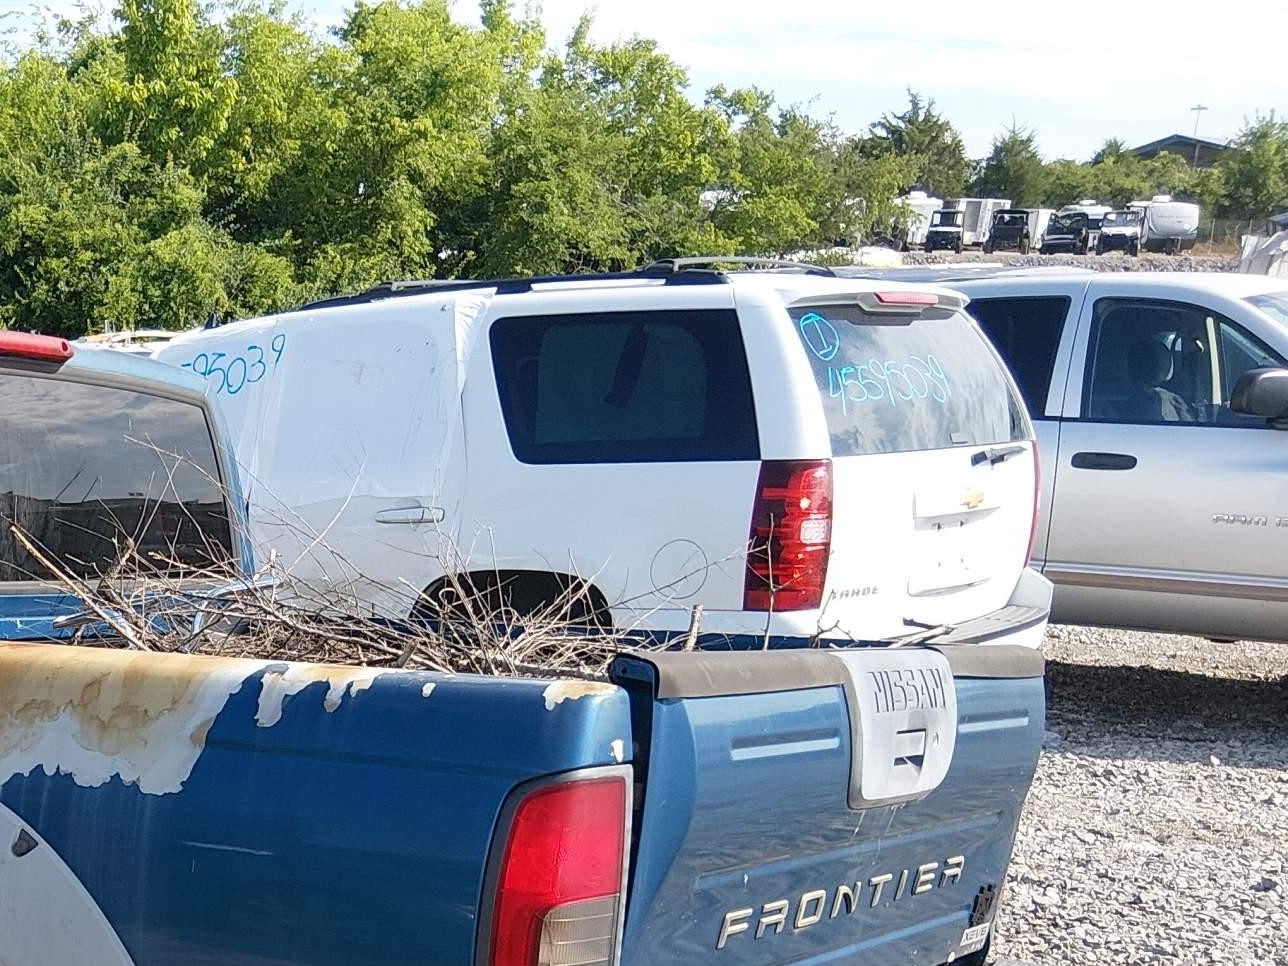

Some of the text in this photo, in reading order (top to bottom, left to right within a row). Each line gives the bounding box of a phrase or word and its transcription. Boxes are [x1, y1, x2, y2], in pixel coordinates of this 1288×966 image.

[181, 334, 286, 394] 95039
[828, 354, 952, 416] 45595039
[867, 667, 947, 713] NISSAN
[716, 855, 965, 950] FRONTIER
